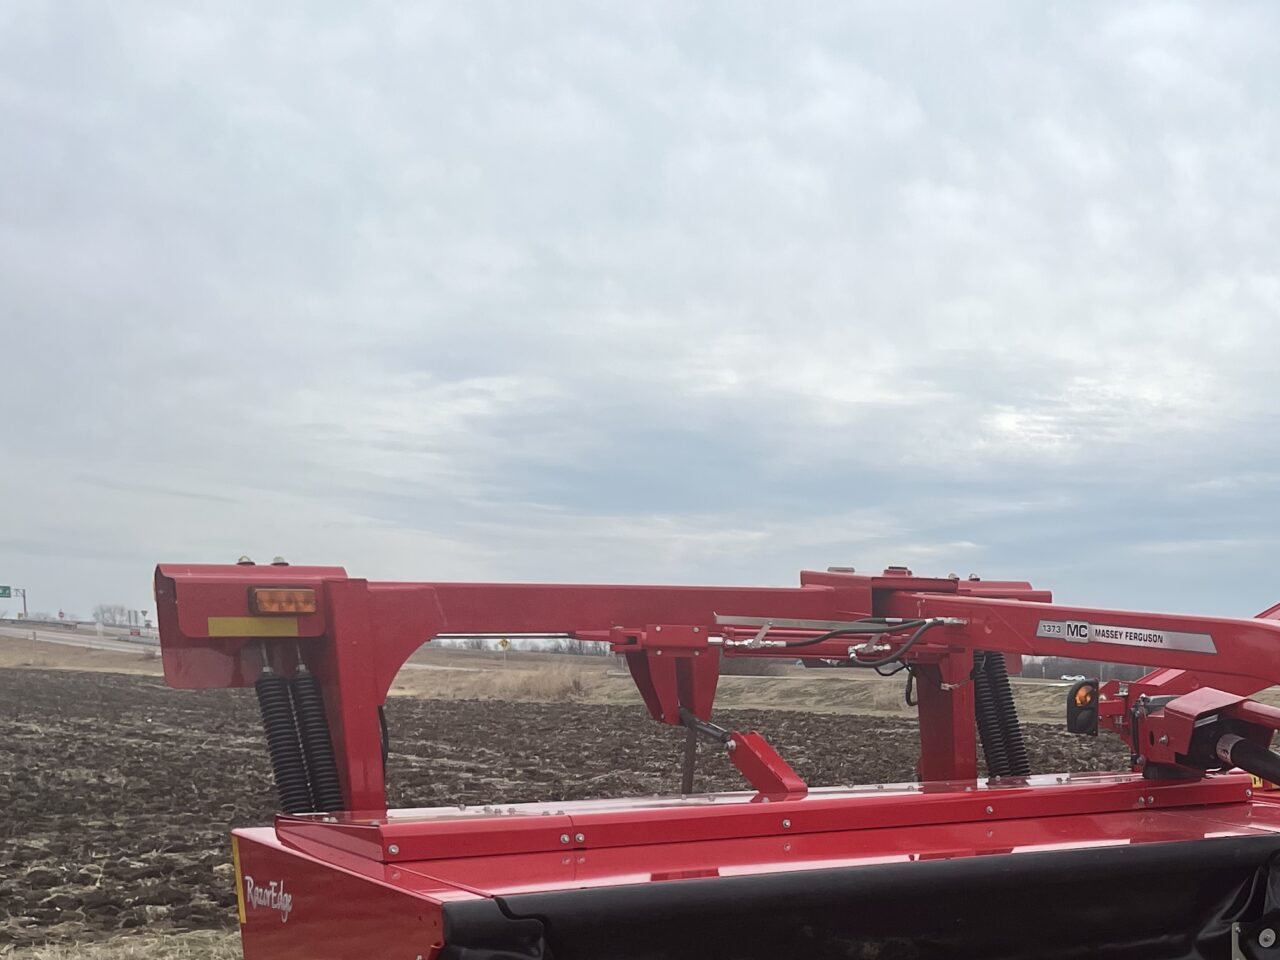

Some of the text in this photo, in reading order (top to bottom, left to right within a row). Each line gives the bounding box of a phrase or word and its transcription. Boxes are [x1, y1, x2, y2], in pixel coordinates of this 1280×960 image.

[1041, 623, 1164, 644] 1373 MC MASSEY FERGUSON
[244, 875, 293, 923] RazorEdge
